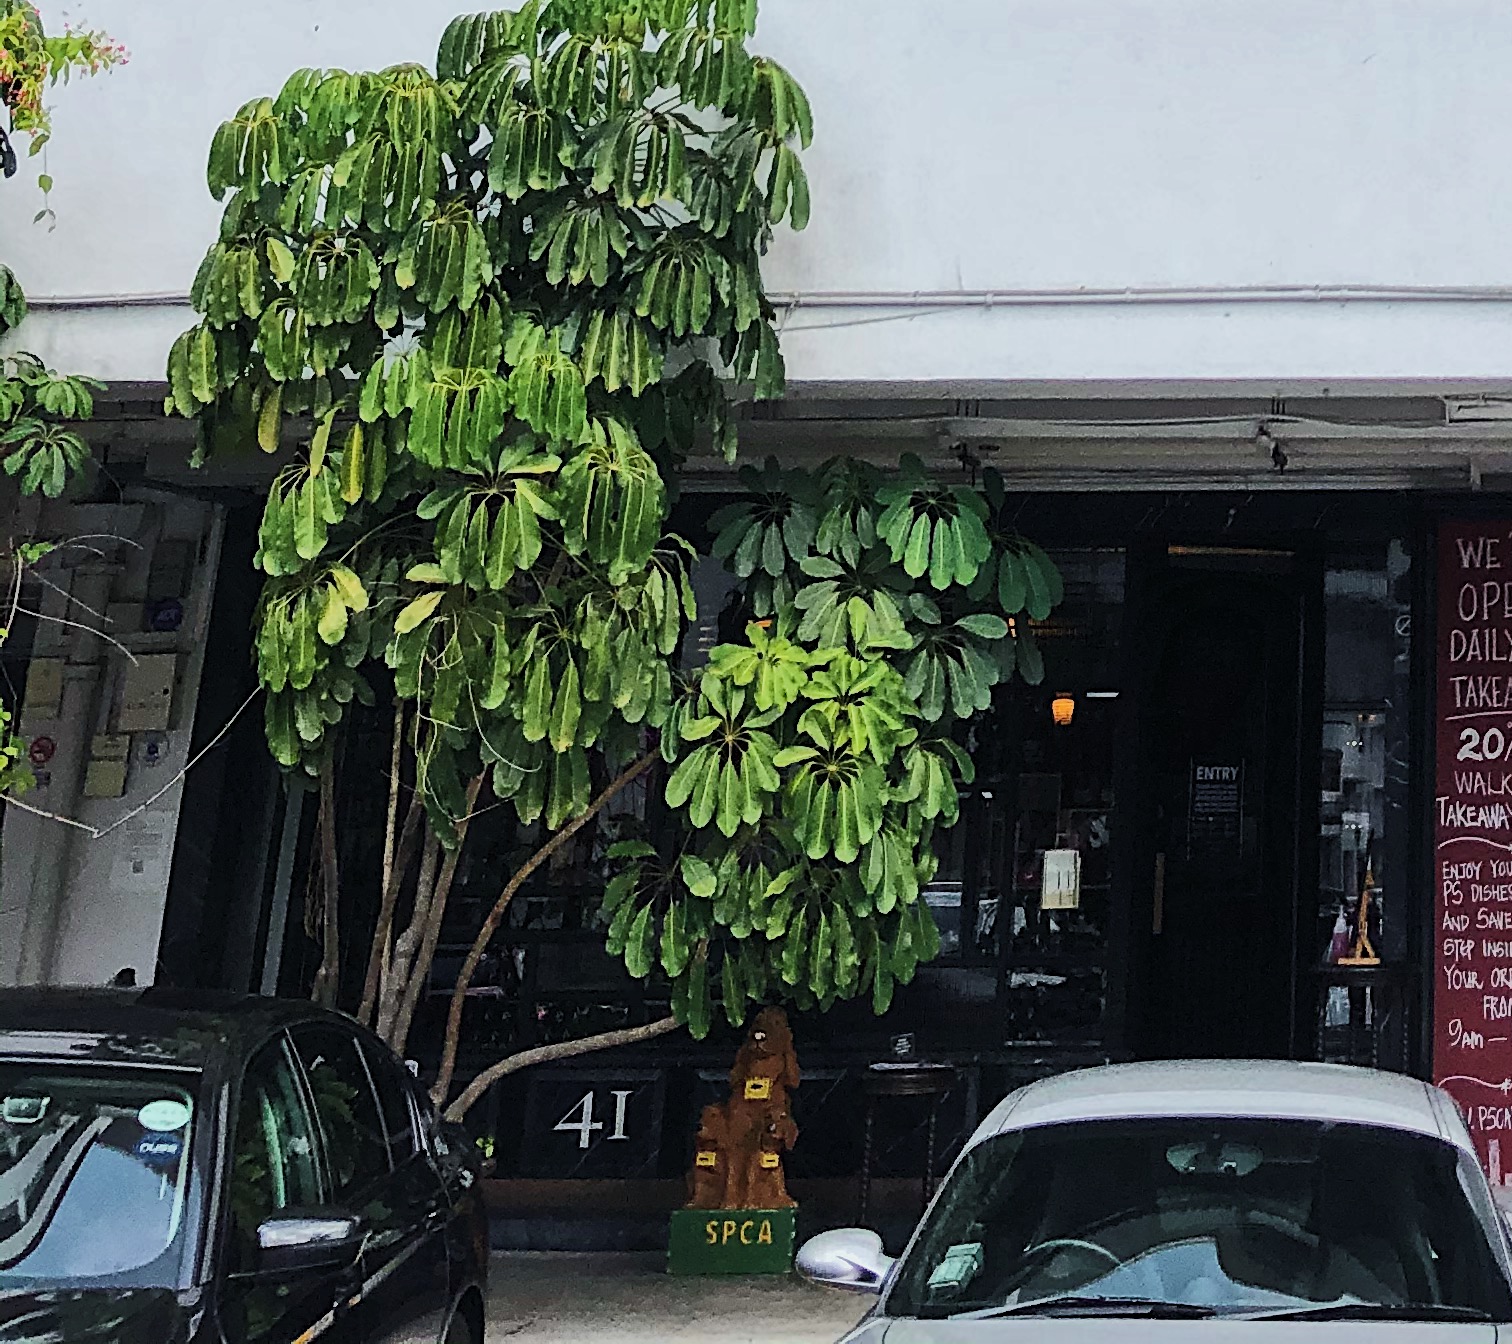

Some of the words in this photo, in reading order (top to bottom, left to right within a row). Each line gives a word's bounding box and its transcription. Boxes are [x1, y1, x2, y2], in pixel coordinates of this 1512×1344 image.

[1196, 766, 1239, 781] ENTRY
[1443, 861, 1482, 880] ENJOY
[1443, 880, 1463, 906] PS
[1443, 911, 1469, 931] AND
[1443, 938, 1475, 961] STEP
[1443, 964, 1484, 990] YOUR
[552, 1090, 634, 1148] 41
[705, 1219, 773, 1246] SPCA
